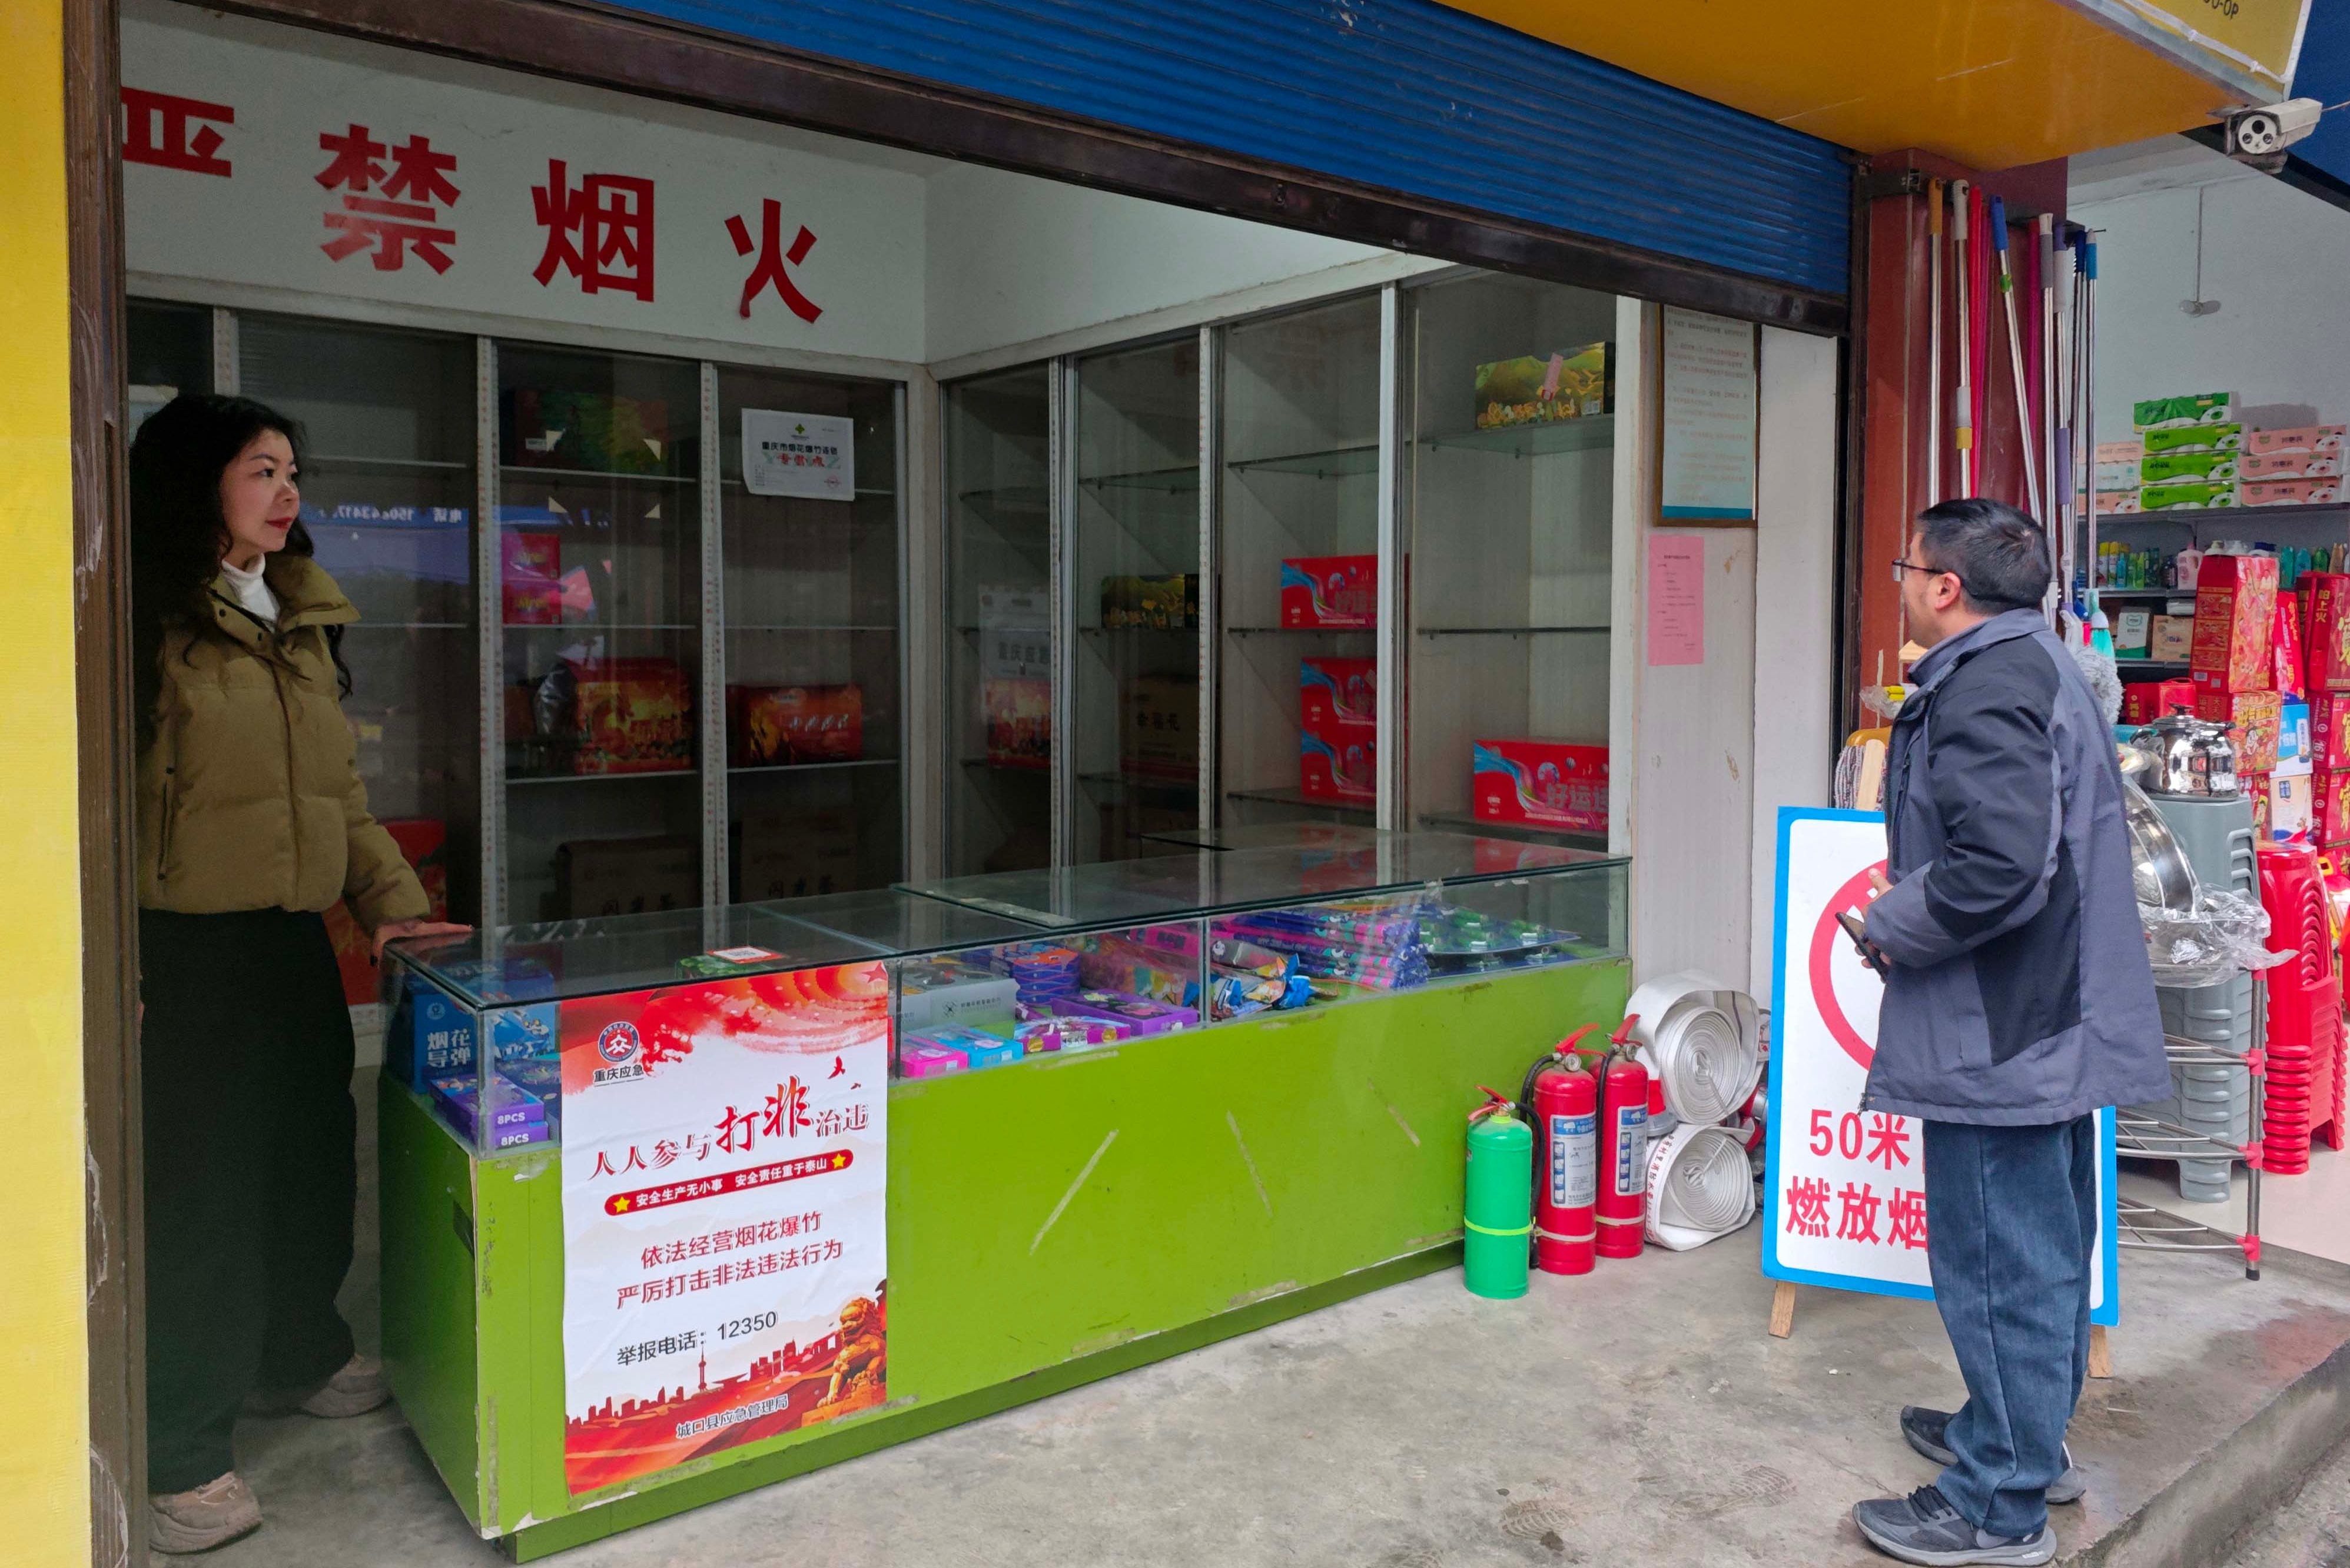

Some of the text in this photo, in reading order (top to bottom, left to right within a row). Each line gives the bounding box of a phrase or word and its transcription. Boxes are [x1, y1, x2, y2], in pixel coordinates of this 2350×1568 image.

[427, 1028, 472, 1050] 烟花
[427, 1048, 472, 1068] 导弹
[593, 1064, 645, 1082] 重庆应急
[497, 1112, 526, 1125] 8PCS
[500, 1133, 530, 1147] 8PCS
[1809, 1109, 1926, 1172] 50米
[636, 1158, 828, 1207] 安全生产无小事 安全责任重于泰山
[1785, 1175, 1930, 1252] 燃放烟
[640, 1210, 822, 1270] 依法经营烟花爆竹
[616, 1238, 844, 1310] 严厉打击非法违法行为
[716, 1311, 778, 1341] 12350
[676, 1392, 790, 1439] 城口县应急管理局
